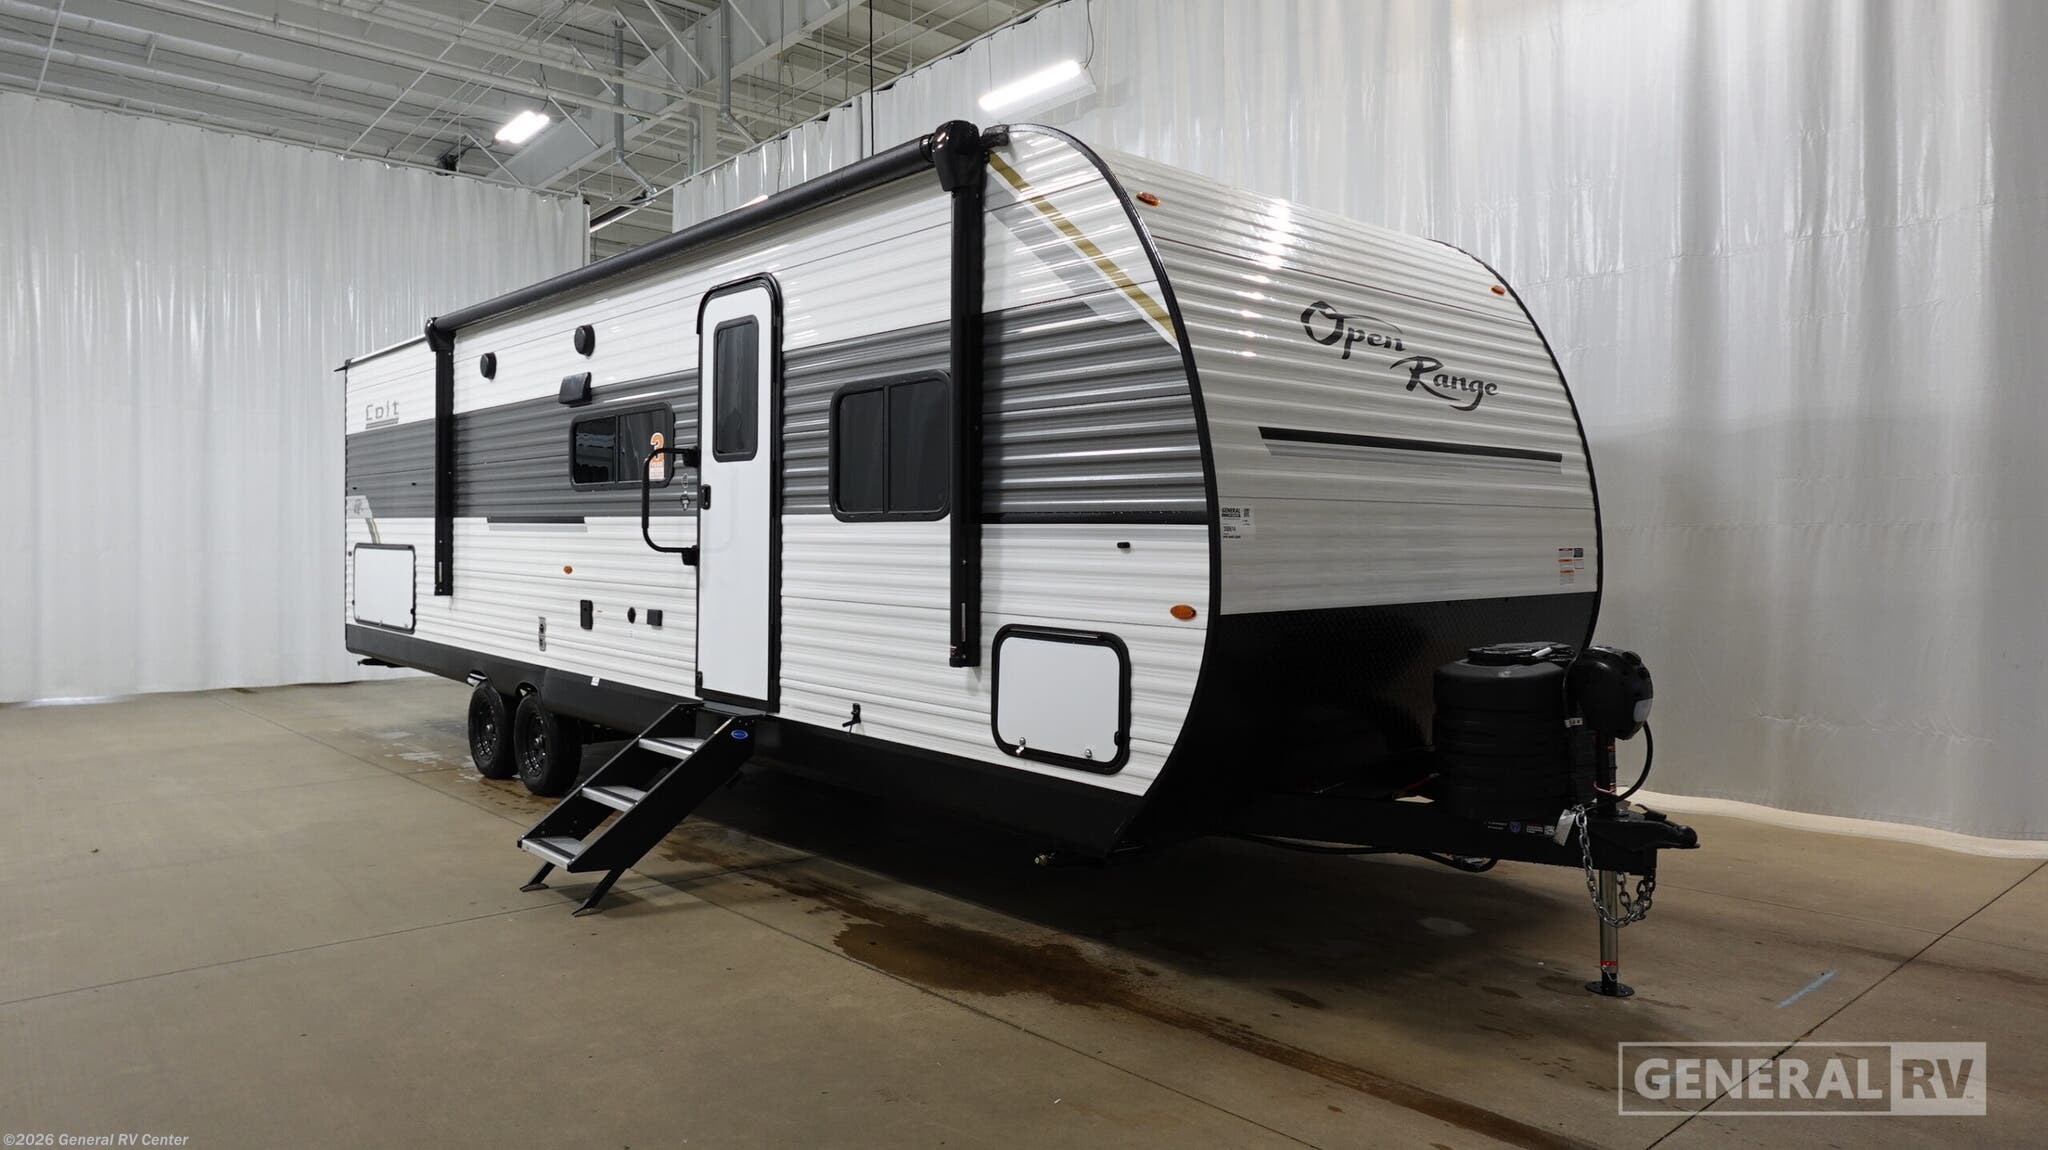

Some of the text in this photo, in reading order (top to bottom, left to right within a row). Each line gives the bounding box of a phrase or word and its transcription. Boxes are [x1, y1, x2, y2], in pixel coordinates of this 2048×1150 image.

[1301, 300, 1499, 411] Open Range
[365, 400, 399, 421] Colt
